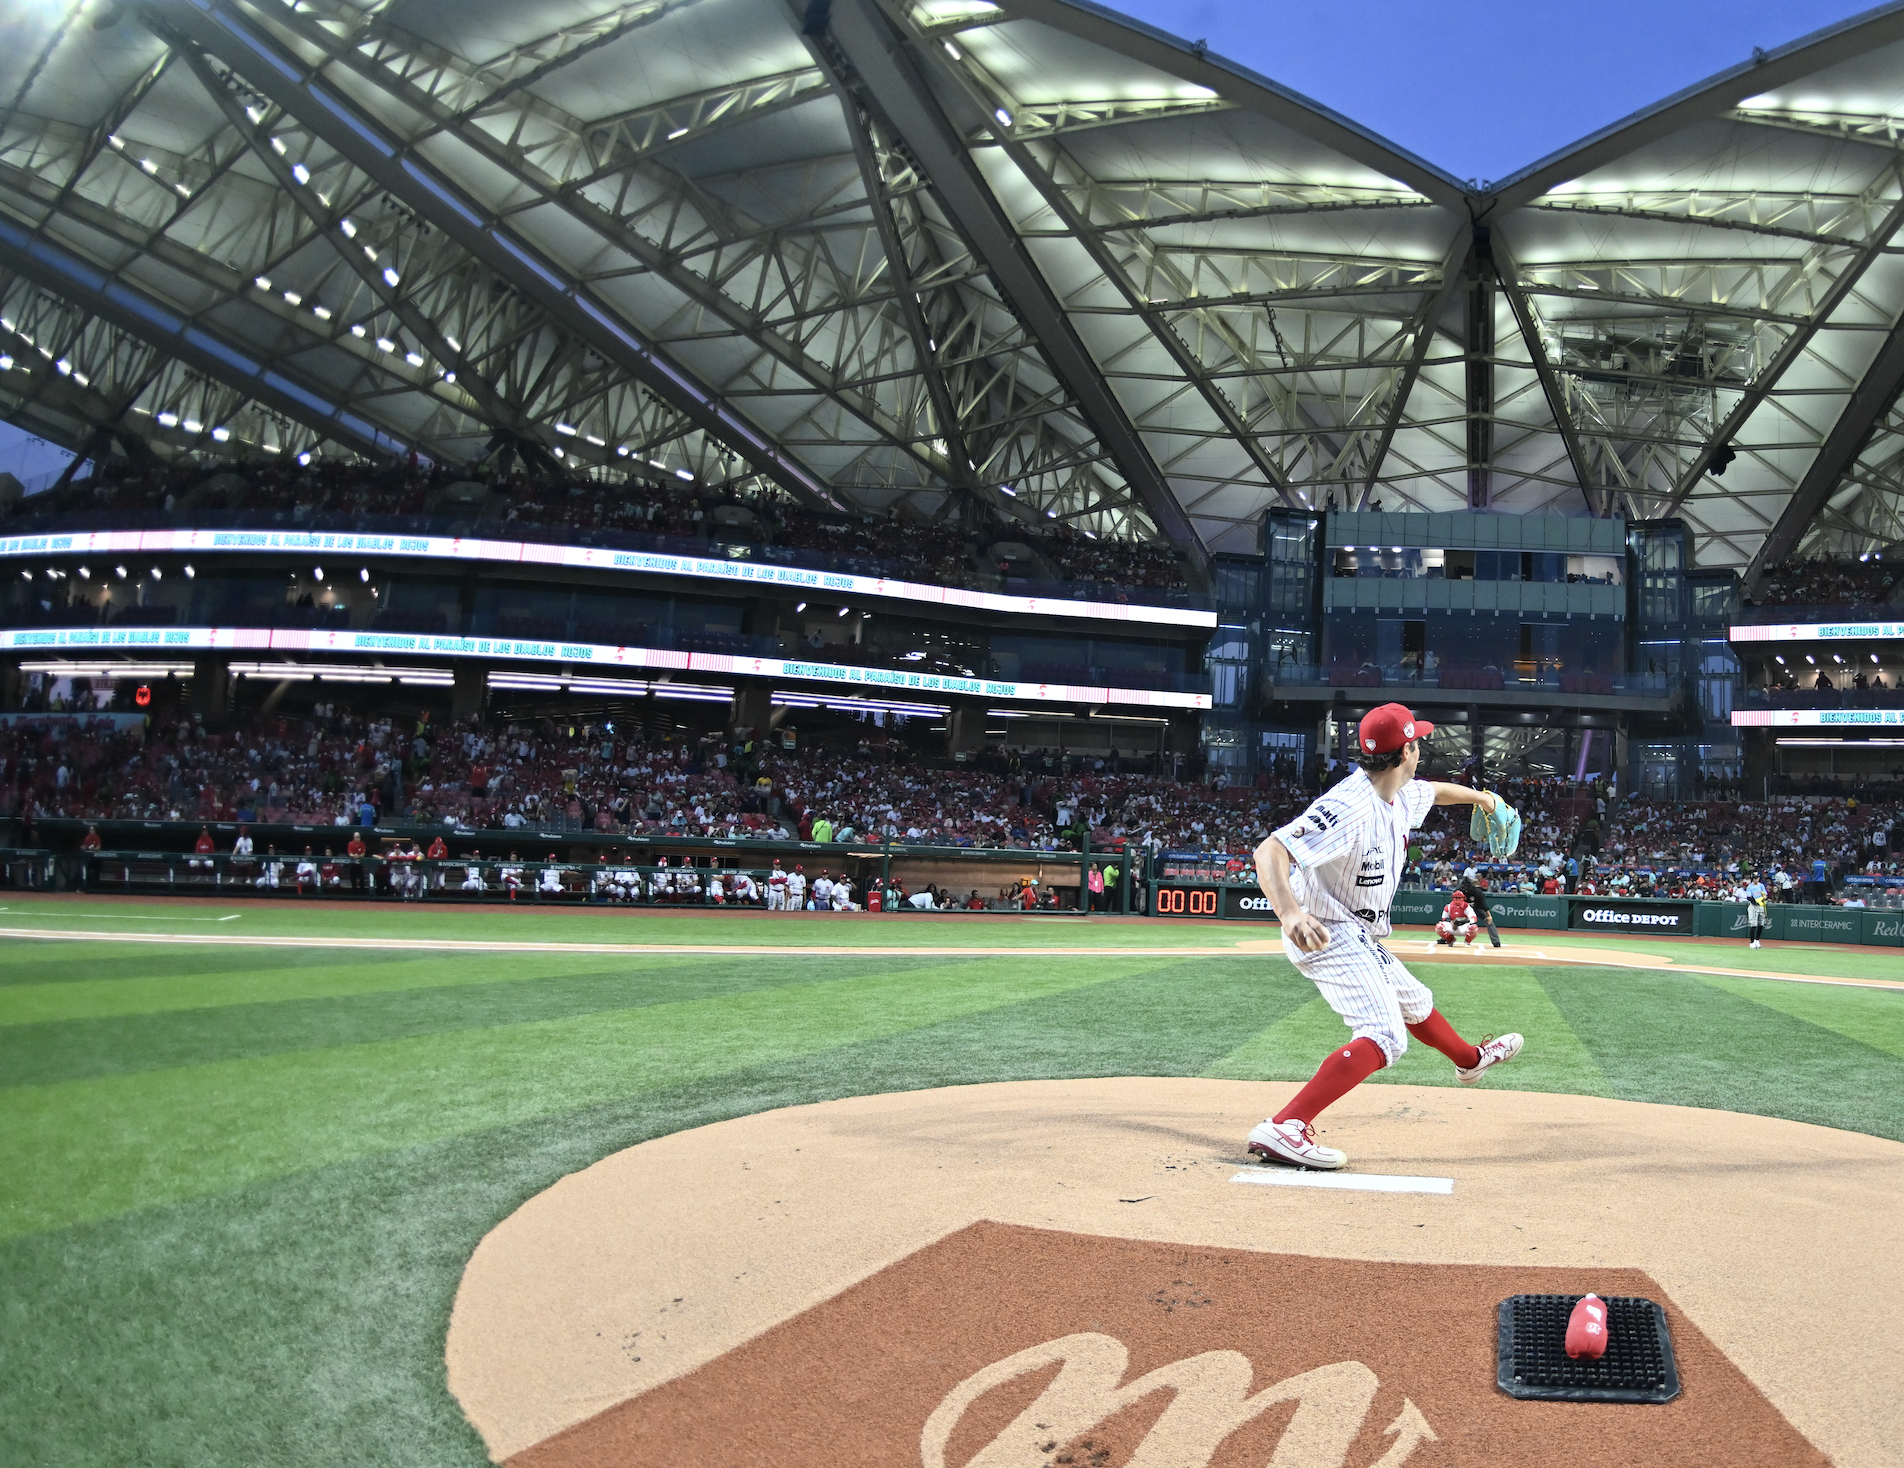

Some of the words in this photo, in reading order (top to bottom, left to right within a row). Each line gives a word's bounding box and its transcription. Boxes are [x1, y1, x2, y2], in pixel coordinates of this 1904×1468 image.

[213, 533, 268, 546] BIENVENIDOS
[269, 534, 281, 546] AL
[323, 536, 335, 547] DE
[336, 536, 354, 548] LOS
[355, 537, 395, 550] DIABLOS
[399, 539, 430, 552] ROJOS
[613, 554, 678, 570] BIENVENIDOS
[680, 559, 693, 572] AL
[742, 566, 755, 577] DE
[756, 567, 775, 580] LOS
[777, 569, 819, 584] DIABLOS
[823, 574, 855, 589] ROJOS
[101, 631, 111, 644] DE
[112, 631, 127, 644] LOS
[128, 631, 160, 644] DIABLOS
[164, 631, 190, 644] ROJOS
[1818, 626, 1880, 637] BIENVENIDOS
[1882, 625, 1895, 636] AL
[354, 634, 416, 649] BIENVENIDOS
[418, 637, 431, 650] AL
[478, 640, 491, 652] DE
[493, 641, 511, 654] LOS
[513, 642, 556, 656] DIABLOS
[561, 645, 593, 659] ROJOS
[783, 663, 847, 679] BIENVENIDOS
[849, 669, 862, 681] AL
[908, 675, 920, 686] DE
[922, 676, 940, 688] LOS
[942, 678, 982, 692] DIABLOS
[986, 683, 1016, 696] ROJOS
[1820, 712, 1882, 723] BIENVENIDOS
[1884, 712, 1898, 723] AL
[1361, 859, 1384, 871] Mobil
[1158, 889, 1185, 913] 00
[1190, 891, 1217, 914] 00
[1507, 906, 1557, 918] Profuturo
[1583, 909, 1630, 923] Office
[1631, 914, 1679, 926] DEPOT
[1799, 918, 1853, 931] INTERCERAMIC
[1872, 920, 1899, 937] Red
